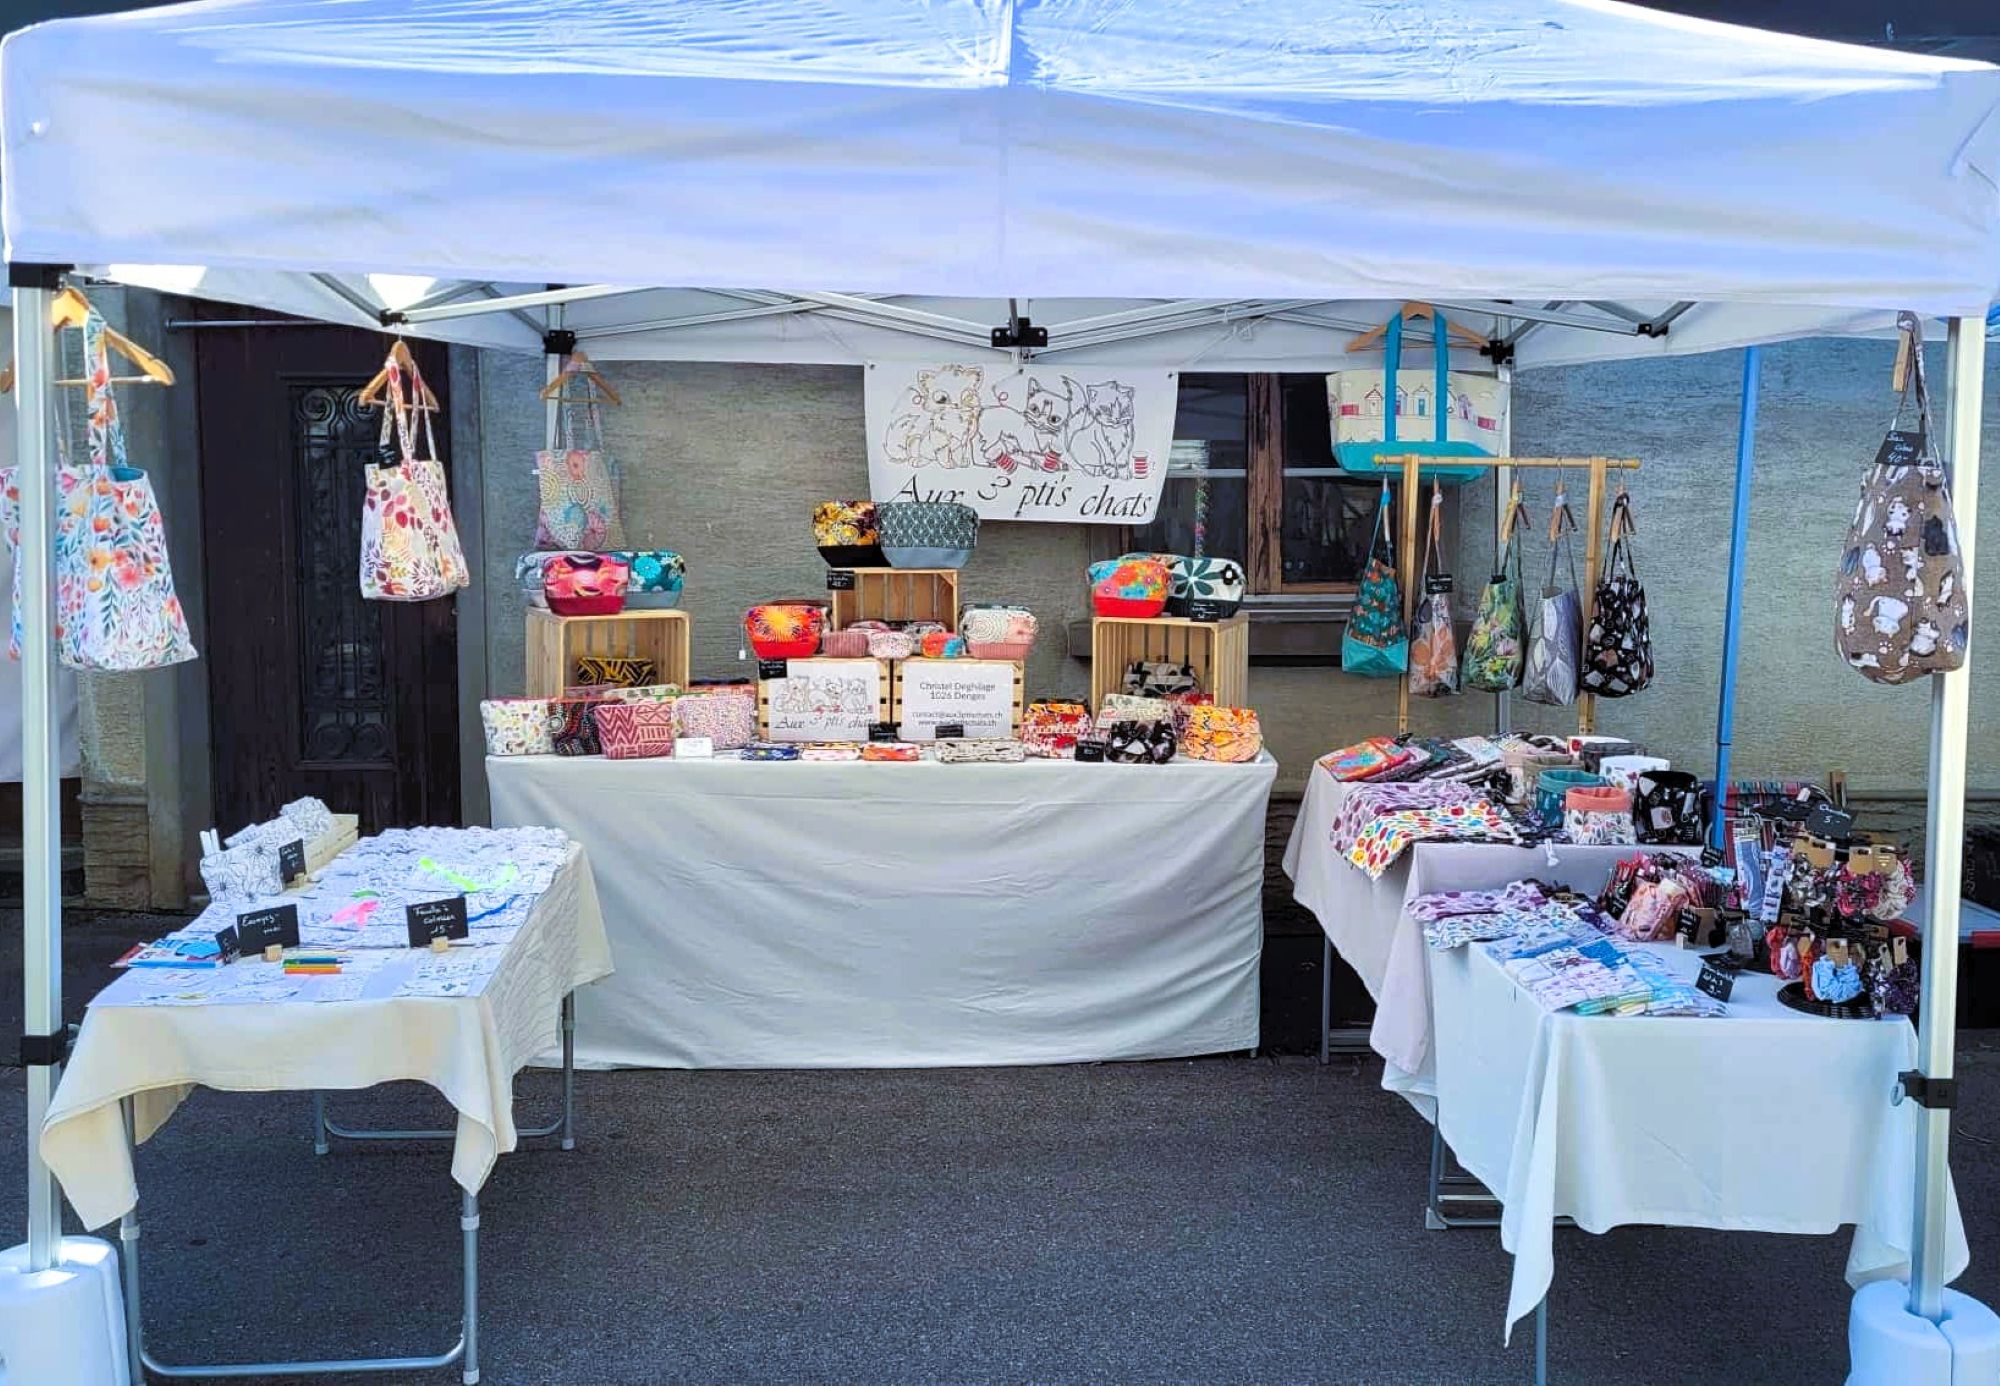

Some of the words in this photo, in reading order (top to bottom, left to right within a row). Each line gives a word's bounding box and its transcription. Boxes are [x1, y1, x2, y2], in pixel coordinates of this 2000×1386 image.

[887, 474, 965, 503] Aux
[978, 475, 1012, 501] 3
[1080, 484, 1153, 517] chats
